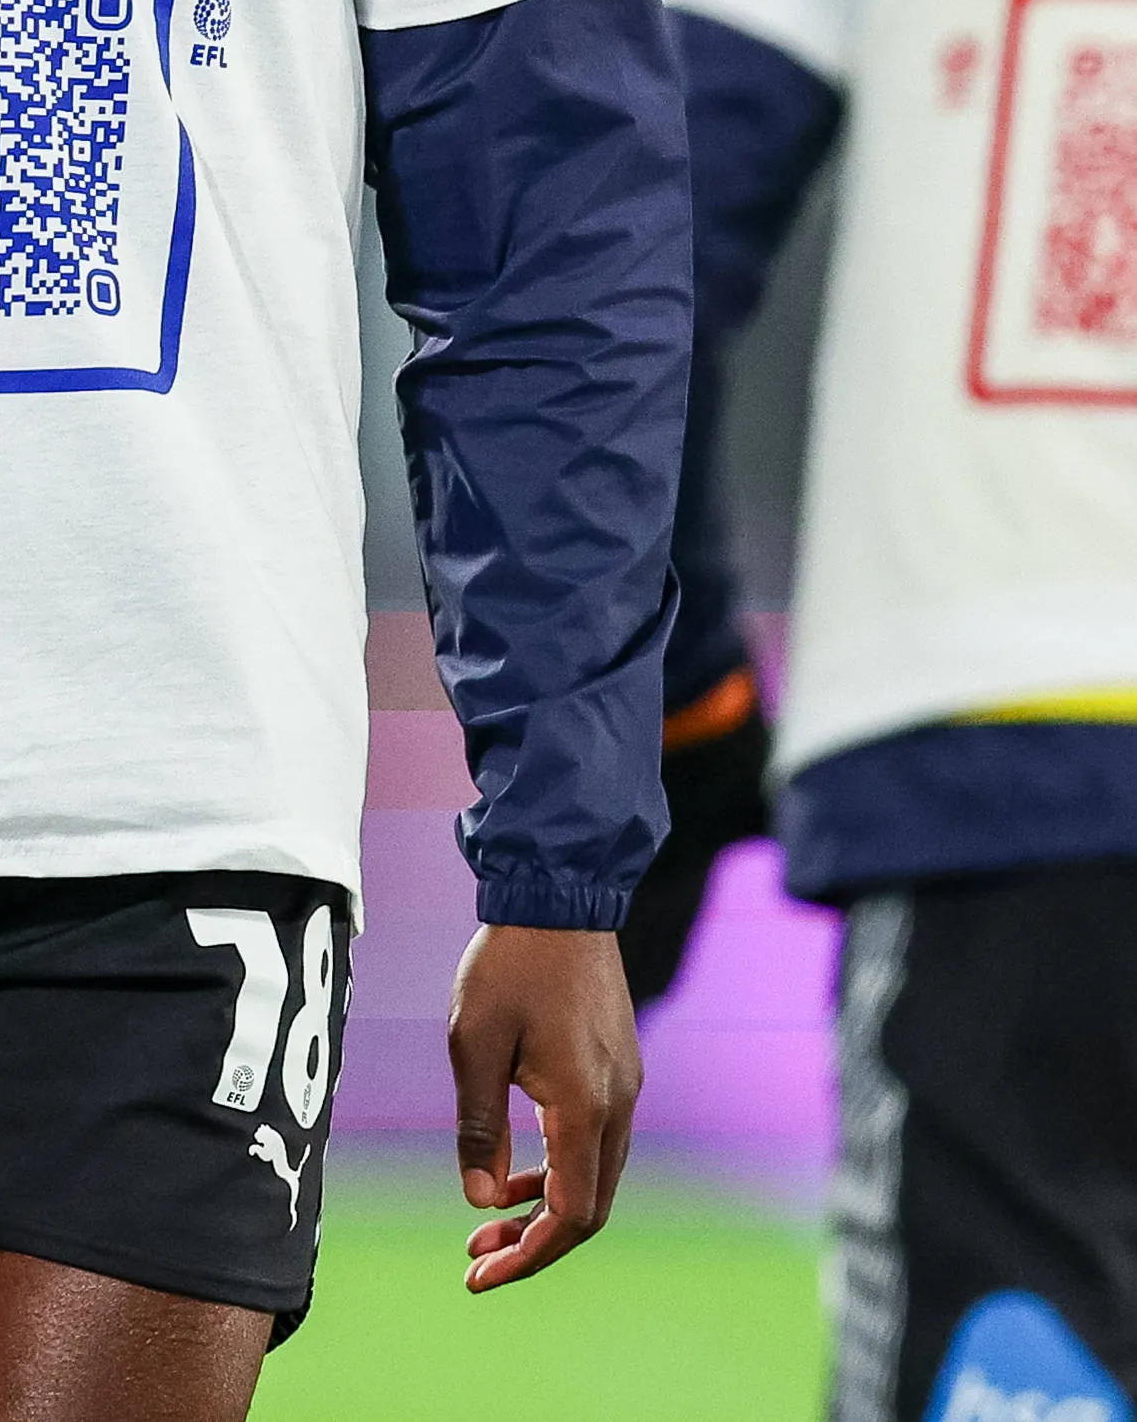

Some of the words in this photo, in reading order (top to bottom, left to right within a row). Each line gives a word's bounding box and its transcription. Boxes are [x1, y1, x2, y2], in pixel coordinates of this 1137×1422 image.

[189, 43, 228, 69] EFL
[185, 905, 334, 1130] 78
[226, 1091, 246, 1106] EFL
